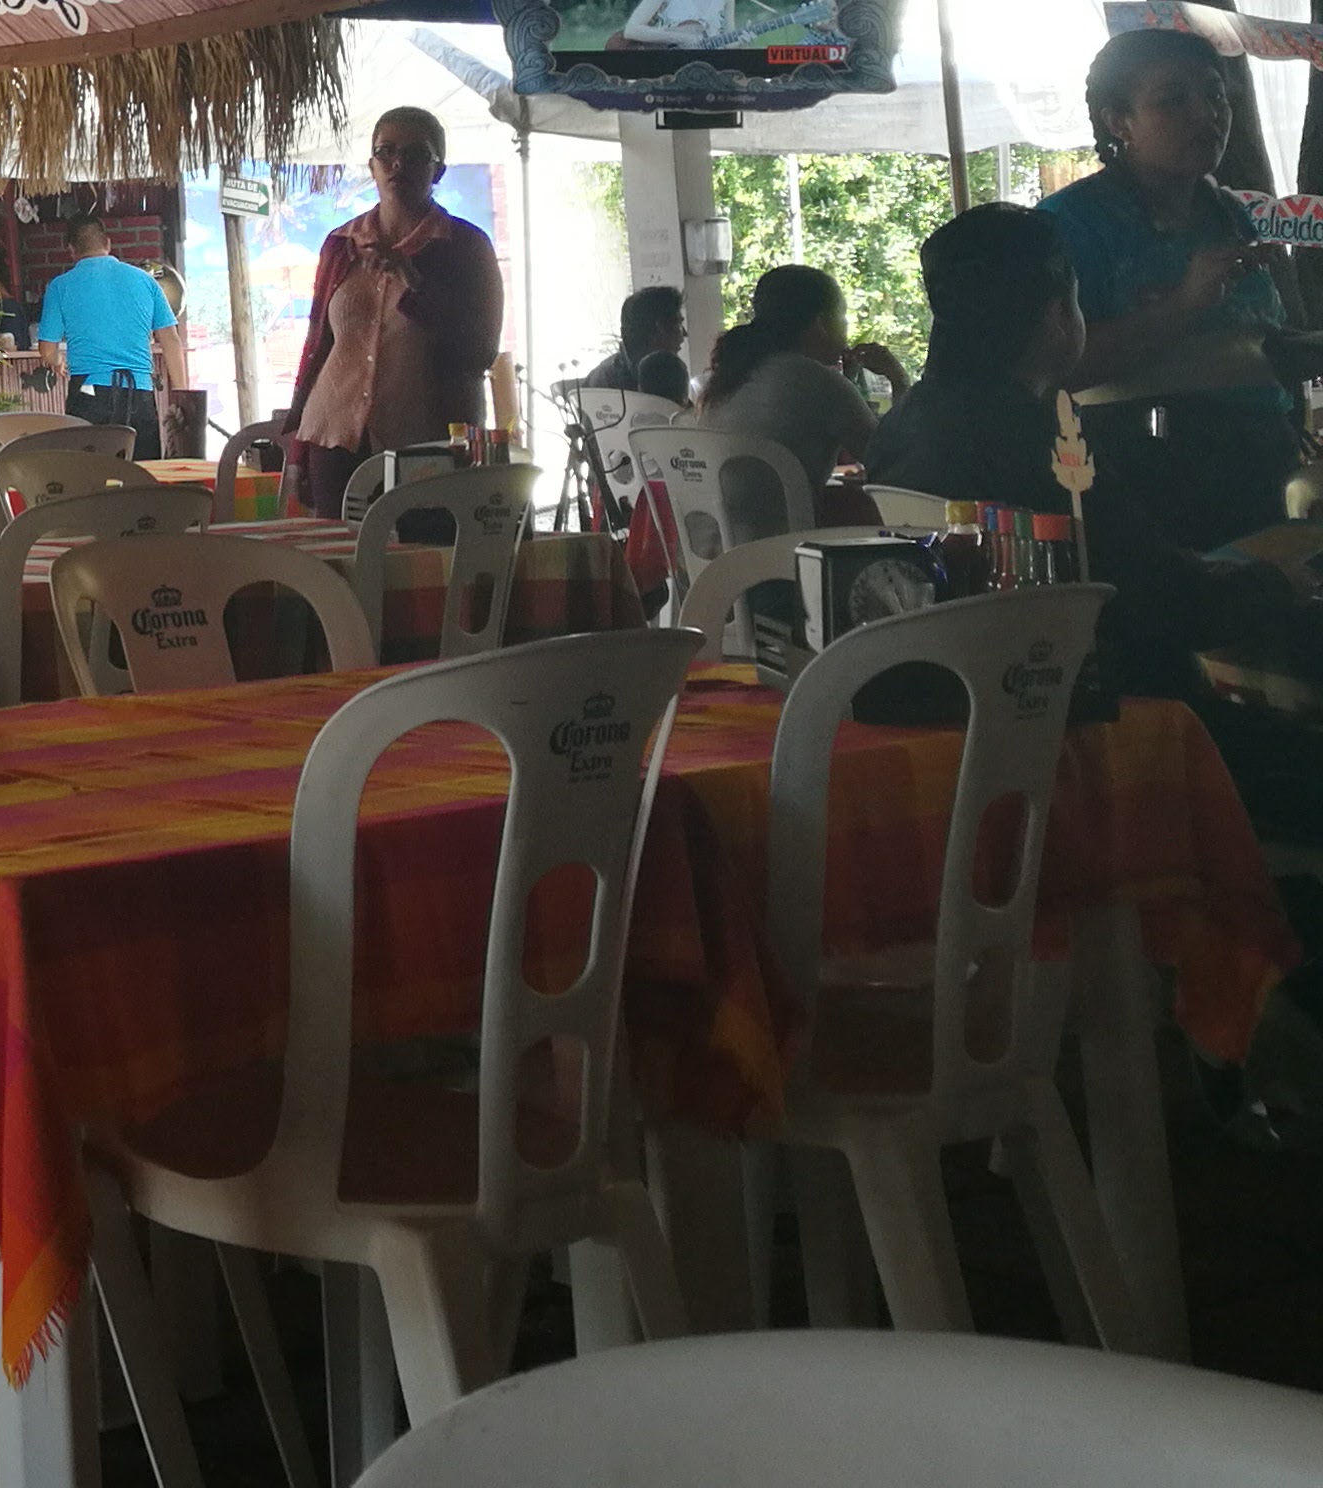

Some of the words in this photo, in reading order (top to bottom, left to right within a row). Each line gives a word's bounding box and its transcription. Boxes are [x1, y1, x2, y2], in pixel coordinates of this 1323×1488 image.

[770, 47, 846, 61] VIRTUALDJ
[247, 182, 259, 192] DE
[670, 455, 707, 472] Corona
[132, 608, 209, 637] Corona
[155, 632, 198, 650] Extra
[1002, 664, 1063, 696] Corona
[550, 719, 632, 758] Corona
